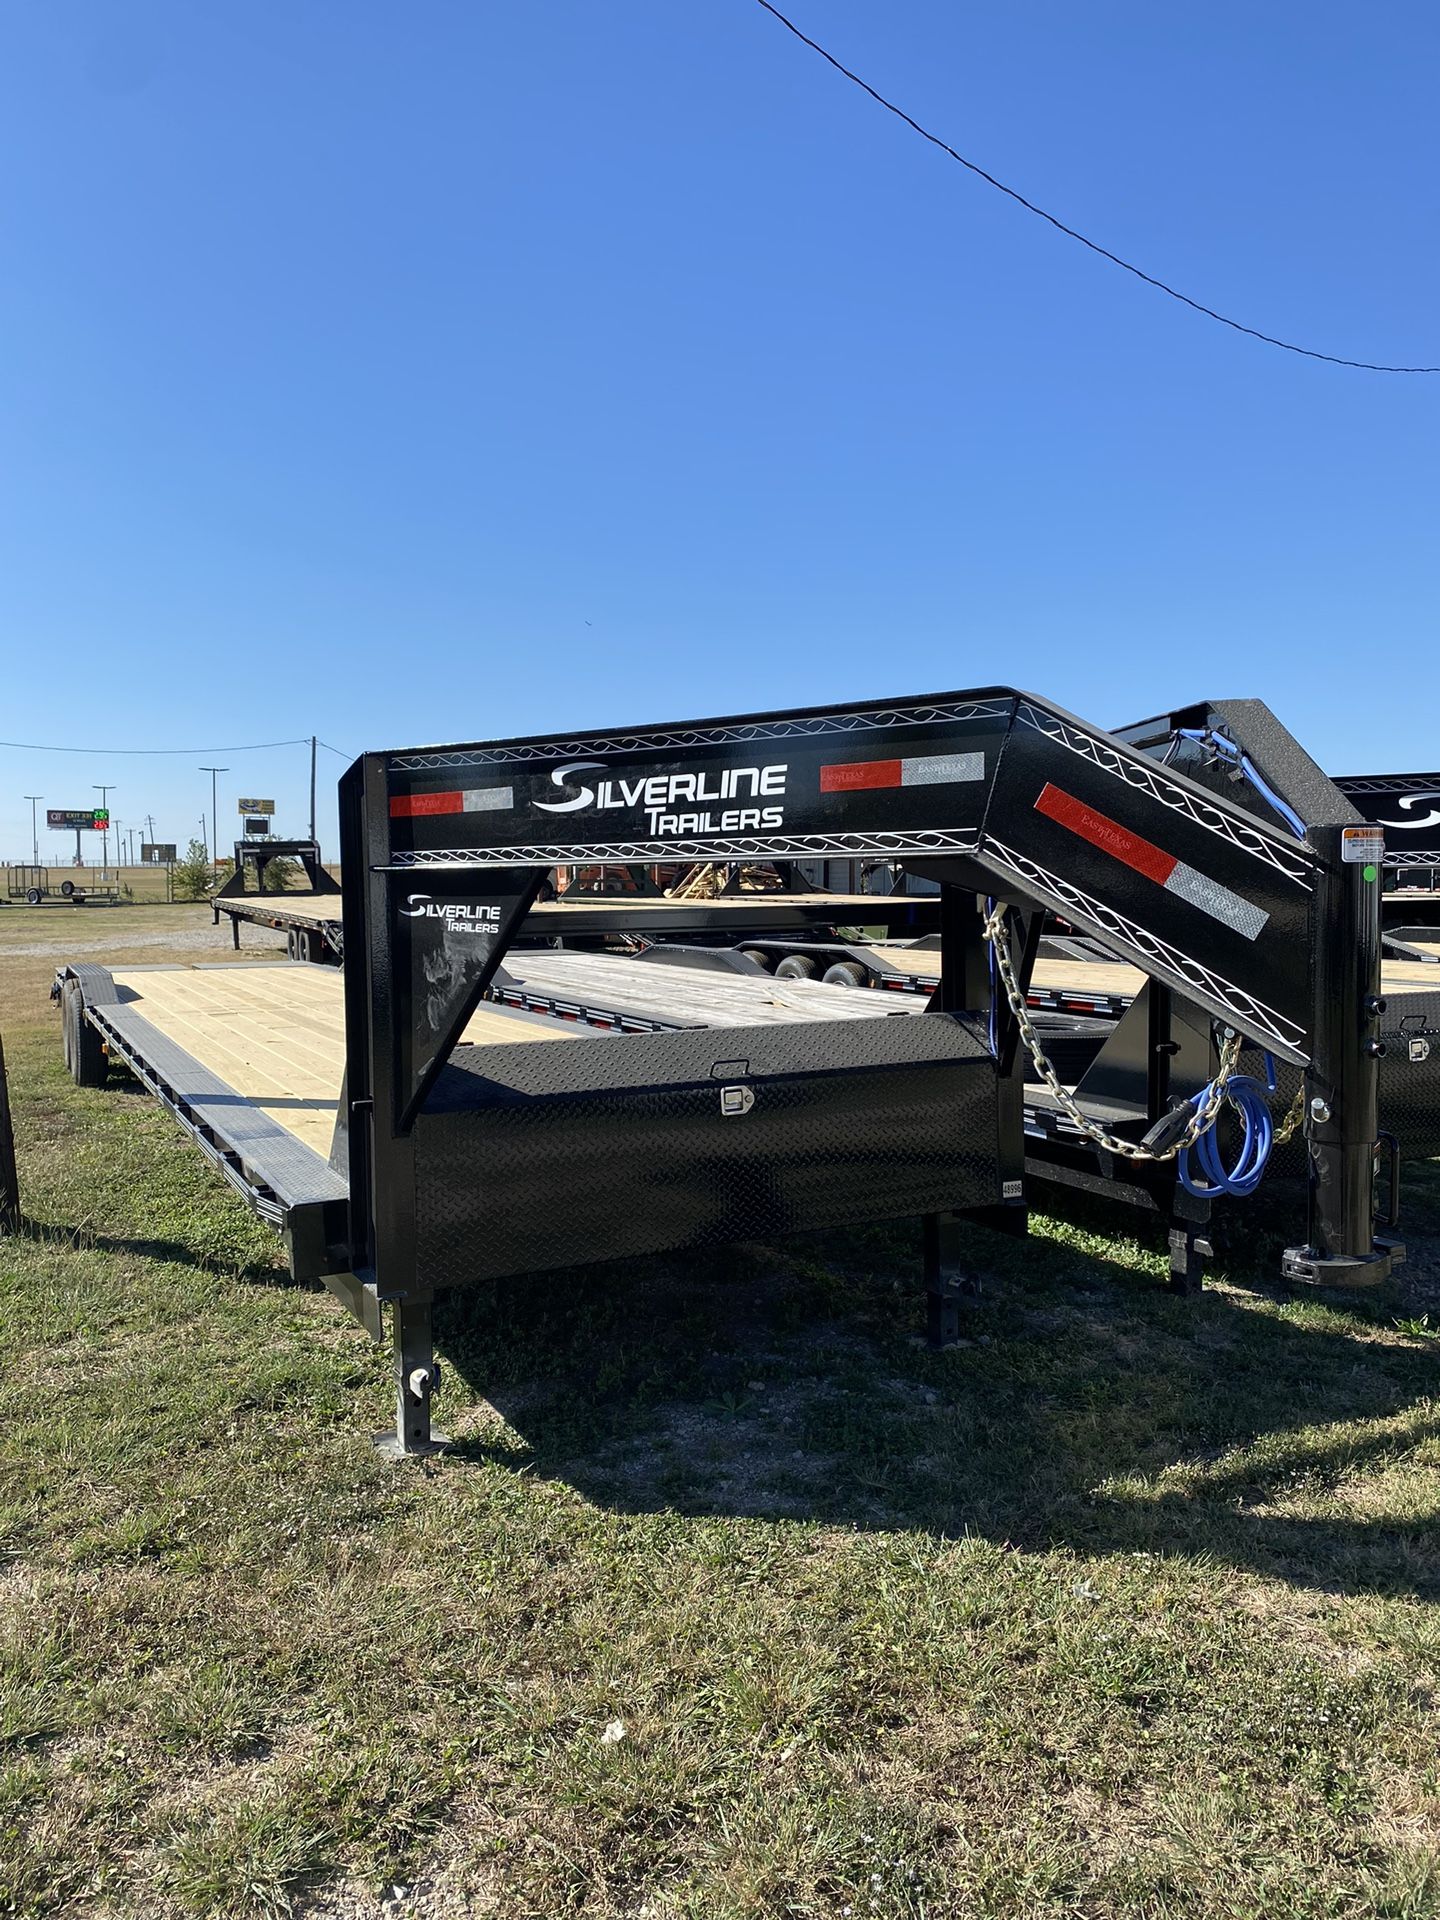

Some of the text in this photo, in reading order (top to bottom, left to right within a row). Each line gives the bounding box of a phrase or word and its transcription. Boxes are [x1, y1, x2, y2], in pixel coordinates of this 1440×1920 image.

[532, 762, 788, 813] SILVERLINE
[644, 806, 784, 836] TRAILERS
[398, 894, 501, 920] SILVERLINE
[446, 918, 500, 934] TRAILERS
